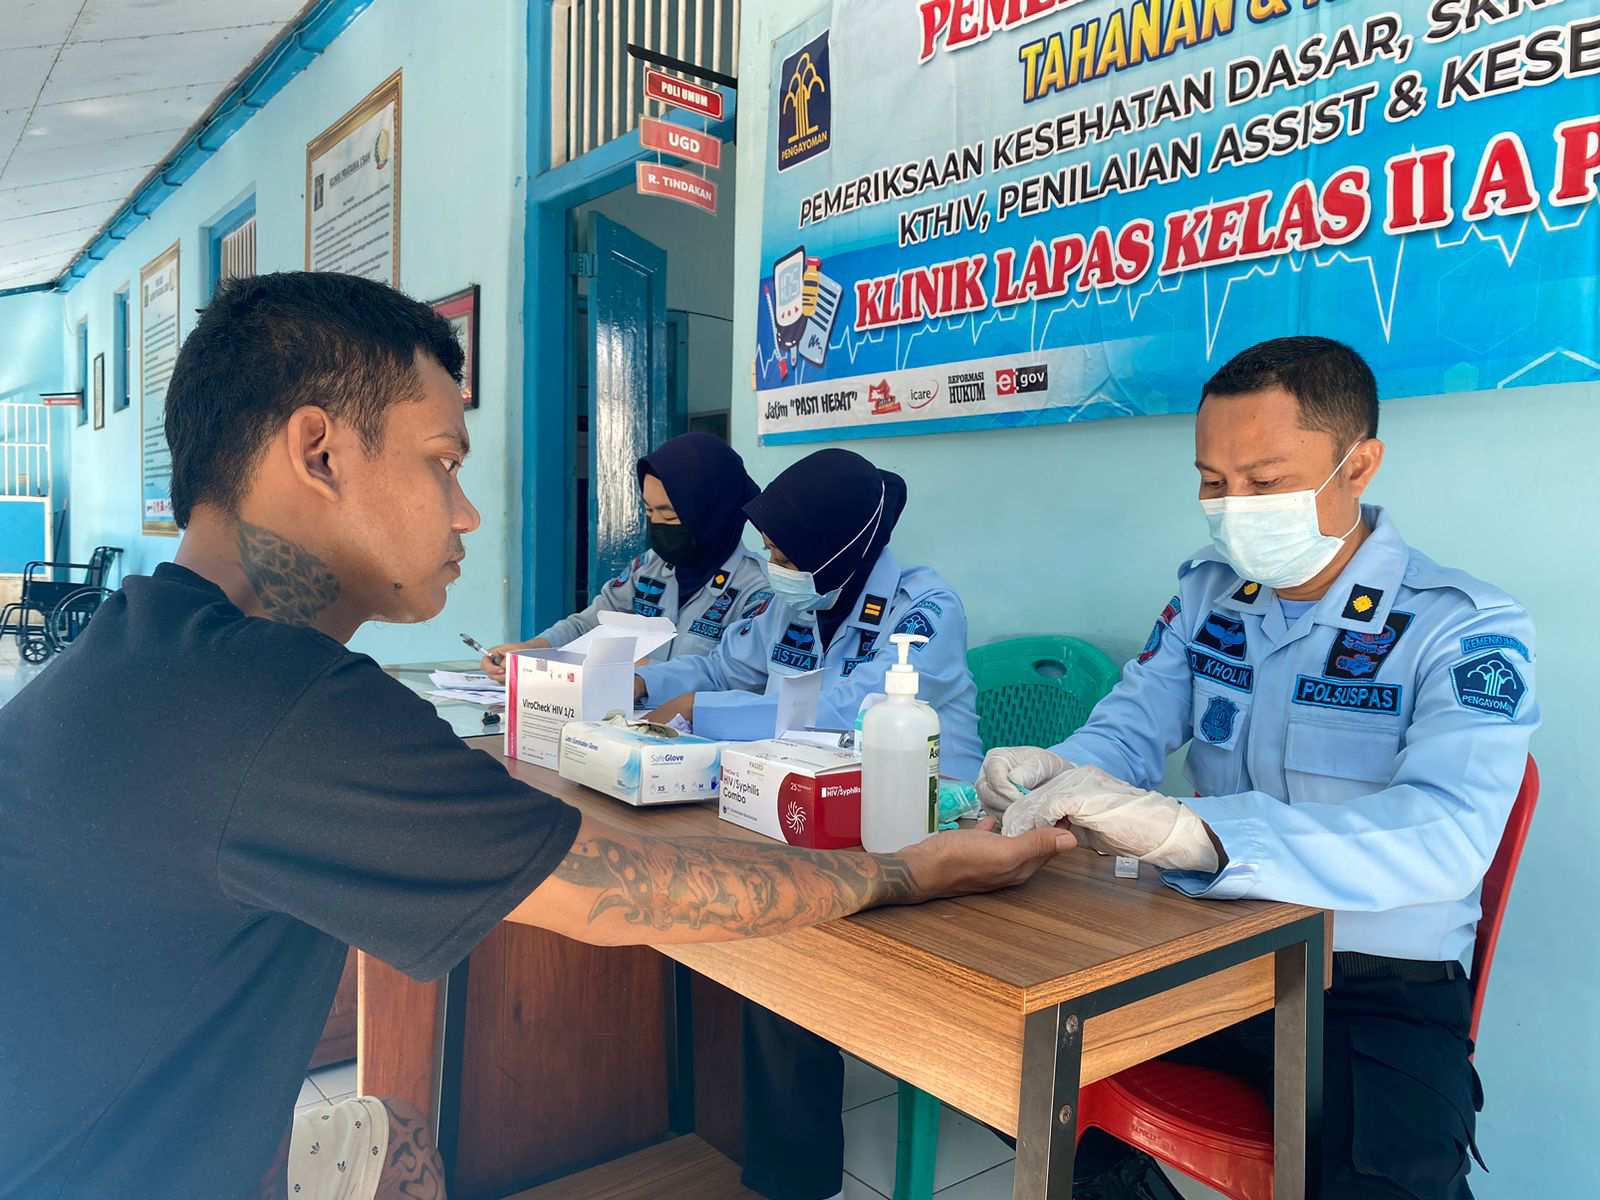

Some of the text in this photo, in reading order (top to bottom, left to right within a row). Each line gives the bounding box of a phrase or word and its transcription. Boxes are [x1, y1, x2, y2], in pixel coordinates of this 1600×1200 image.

[1019, 0, 1234, 103] TAHANAN
[661, 81, 708, 107] POLI UMUM
[799, 143, 983, 228] PEMERIKSAAN
[992, 71, 1212, 171] KESEHATAN
[1227, 15, 1412, 102] DASAR,
[669, 132, 700, 153] UGD
[781, 130, 828, 161] PENGAYOMAN
[899, 190, 990, 246] KTHIV,
[998, 135, 1200, 221] PENILAIAN
[1210, 86, 1376, 169] ASSIST
[1386, 73, 1426, 122] &
[648, 173, 712, 201] R. TINDAKAN
[854, 258, 988, 332] KLINIK
[993, 219, 1154, 305] LAPAS
[1159, 166, 1370, 275] KELAS
[1386, 145, 1453, 234] II
[1464, 132, 1538, 221] A
[948, 371, 985, 385] REFORMASI
[910, 388, 932, 401] icare
[948, 383, 986, 404] HUKUM
[765, 401, 788, 420] Jatim
[1203, 658, 1250, 687] KHOLIK
[1301, 682, 1393, 709] POLSUSPAS
[522, 698, 575, 719] ViroCheck HIV 1/2
[651, 753, 683, 763] SafeGlove
[723, 775, 760, 797] HIV/Syphilis
[723, 786, 746, 804] Combo
